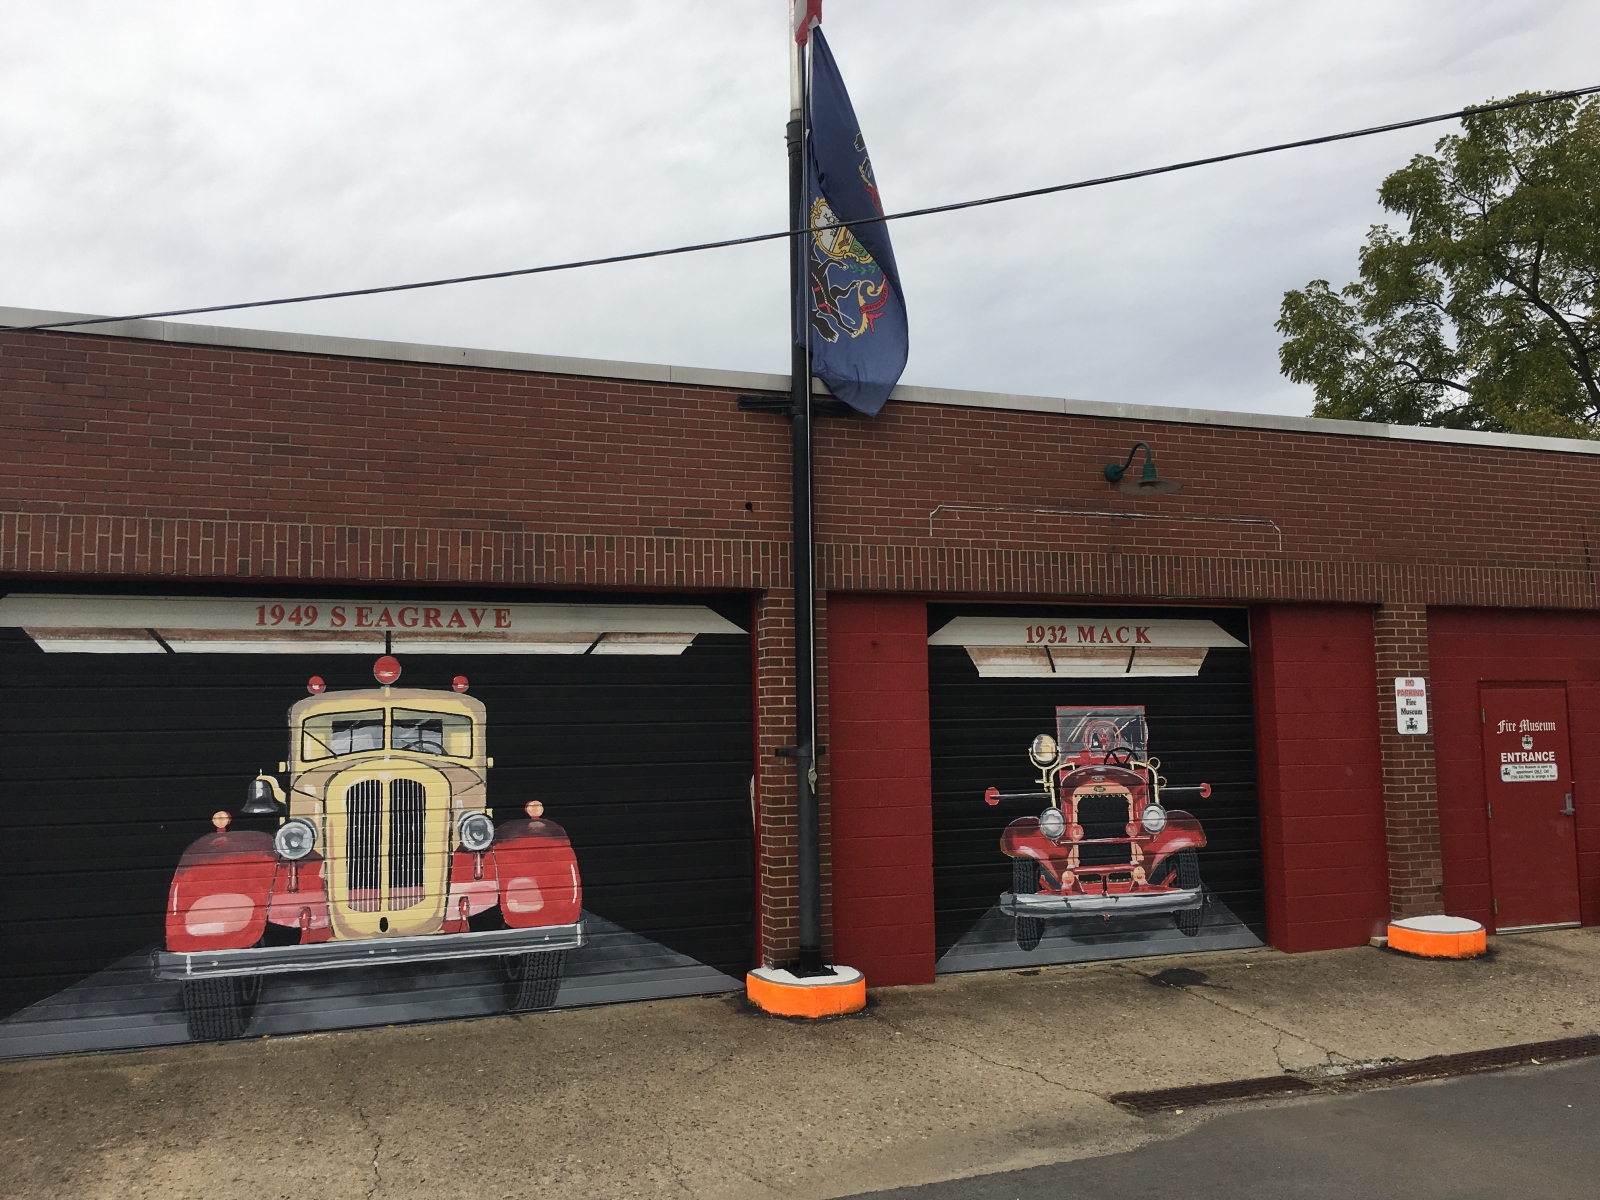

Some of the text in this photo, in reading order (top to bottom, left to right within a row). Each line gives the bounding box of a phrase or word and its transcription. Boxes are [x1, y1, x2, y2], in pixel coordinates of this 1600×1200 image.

[256, 604, 511, 628] 1949 SEAGRAVE
[1026, 625, 1151, 644] 1932 MACK
[1397, 689, 1424, 697] PARKING
[1496, 719, 1556, 734] Fire Museum
[1501, 751, 1555, 762] ENTRANCE
